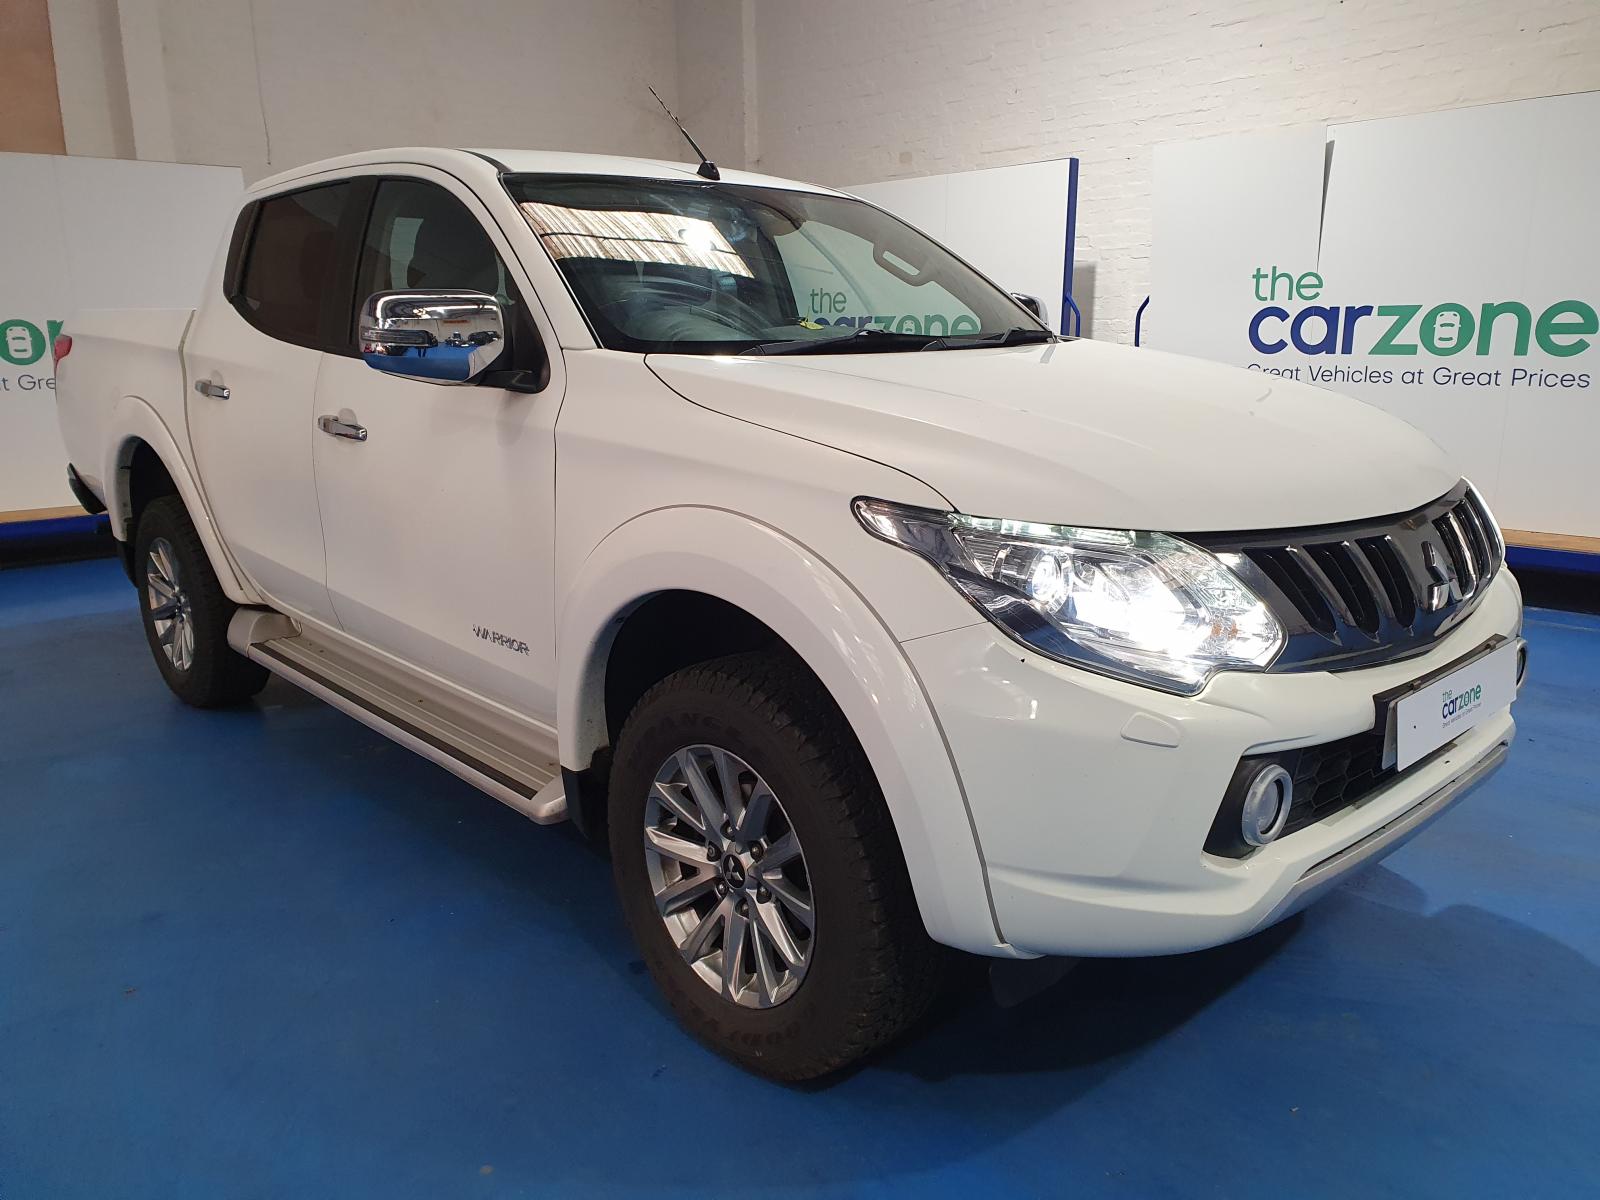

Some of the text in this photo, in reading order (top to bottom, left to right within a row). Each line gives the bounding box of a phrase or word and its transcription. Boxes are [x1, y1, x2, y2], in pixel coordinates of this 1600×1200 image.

[810, 287, 847, 314] the
[1252, 265, 1324, 302] the
[1248, 299, 1600, 358] carzone
[1308, 365, 1394, 385] Vehicles
[1401, 366, 1424, 386] at
[1432, 366, 1502, 387] Great
[1511, 367, 1592, 389] Prices
[472, 623, 530, 657] WARRIOR
[1441, 683, 1482, 720] carzone
